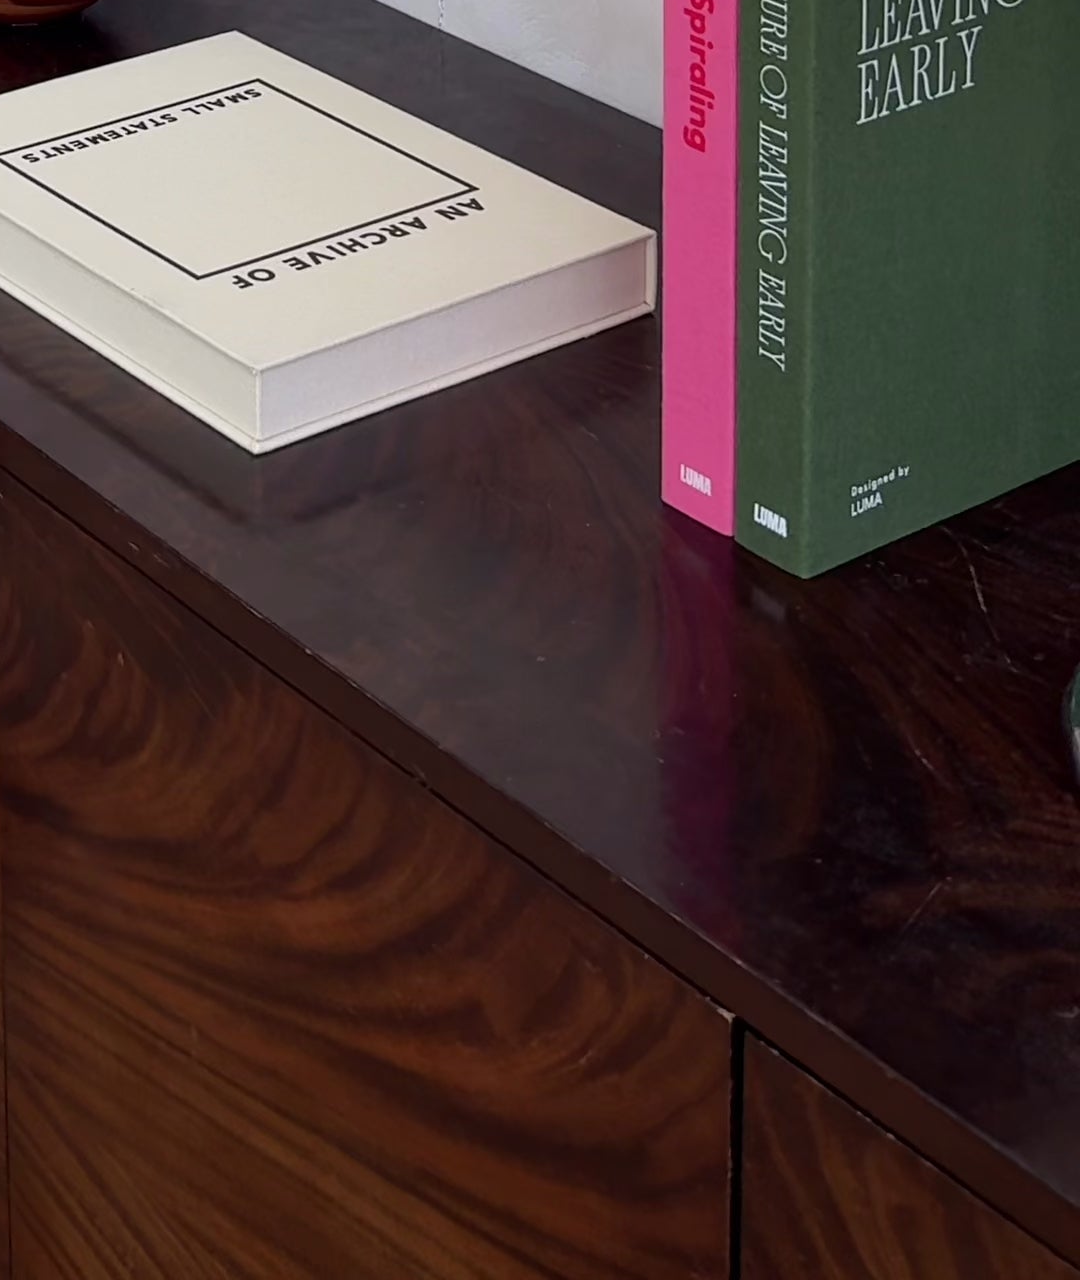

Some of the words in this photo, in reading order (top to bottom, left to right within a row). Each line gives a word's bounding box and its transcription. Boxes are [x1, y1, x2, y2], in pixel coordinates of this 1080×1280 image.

[759, 64, 787, 120] OF
[856, 25, 983, 126] EARLY
[180, 88, 262, 115] SMALL
[21, 113, 178, 164] STATEMENTS
[433, 198, 486, 221] AN
[758, 120, 788, 265] LEAVING
[281, 216, 428, 271] ARCHIVE
[231, 268, 276, 289] OF
[758, 268, 786, 372] EARLY
[680, 463, 712, 496] LUMA
[851, 469, 896, 497] Designed
[898, 466, 911, 477] by
[754, 502, 788, 538] LUMA
[851, 492, 883, 517] LUMA
